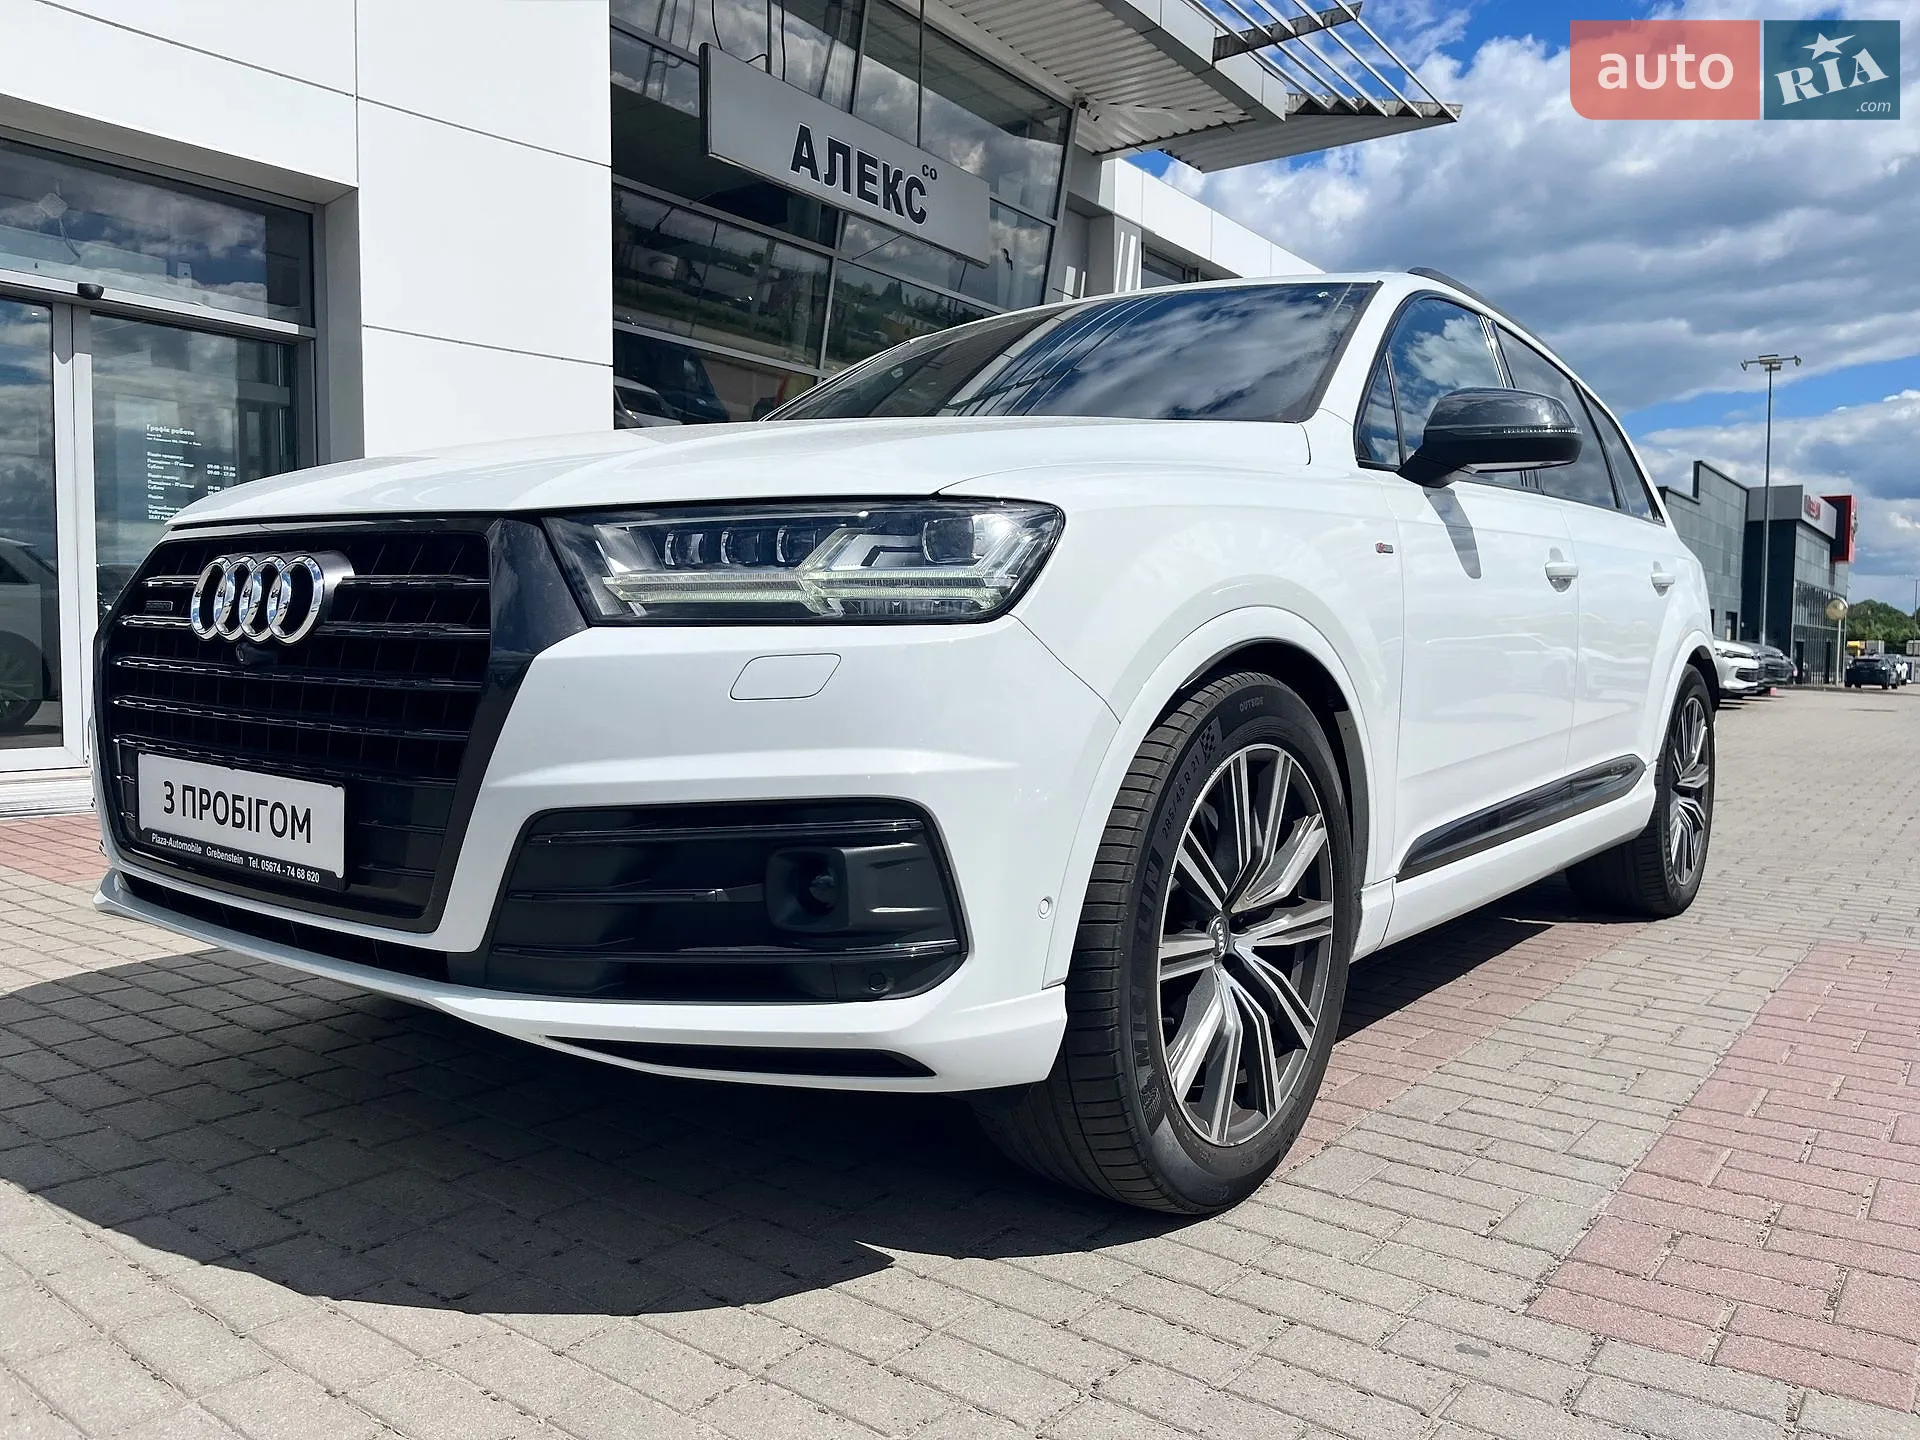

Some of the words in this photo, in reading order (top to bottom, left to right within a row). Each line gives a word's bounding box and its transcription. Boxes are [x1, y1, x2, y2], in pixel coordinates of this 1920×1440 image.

[790, 121, 928, 226] АЛЕКС
[182, 784, 312, 844] ПРОБІГОМ
[151, 832, 202, 854] Plaza-Automobile
[206, 846, 244, 865] Grebenstein
[248, 856, 260, 868] Tel.
[261, 860, 281, 875] 05674
[286, 865, 295, 878] 74
[306, 871, 320, 883] 620
